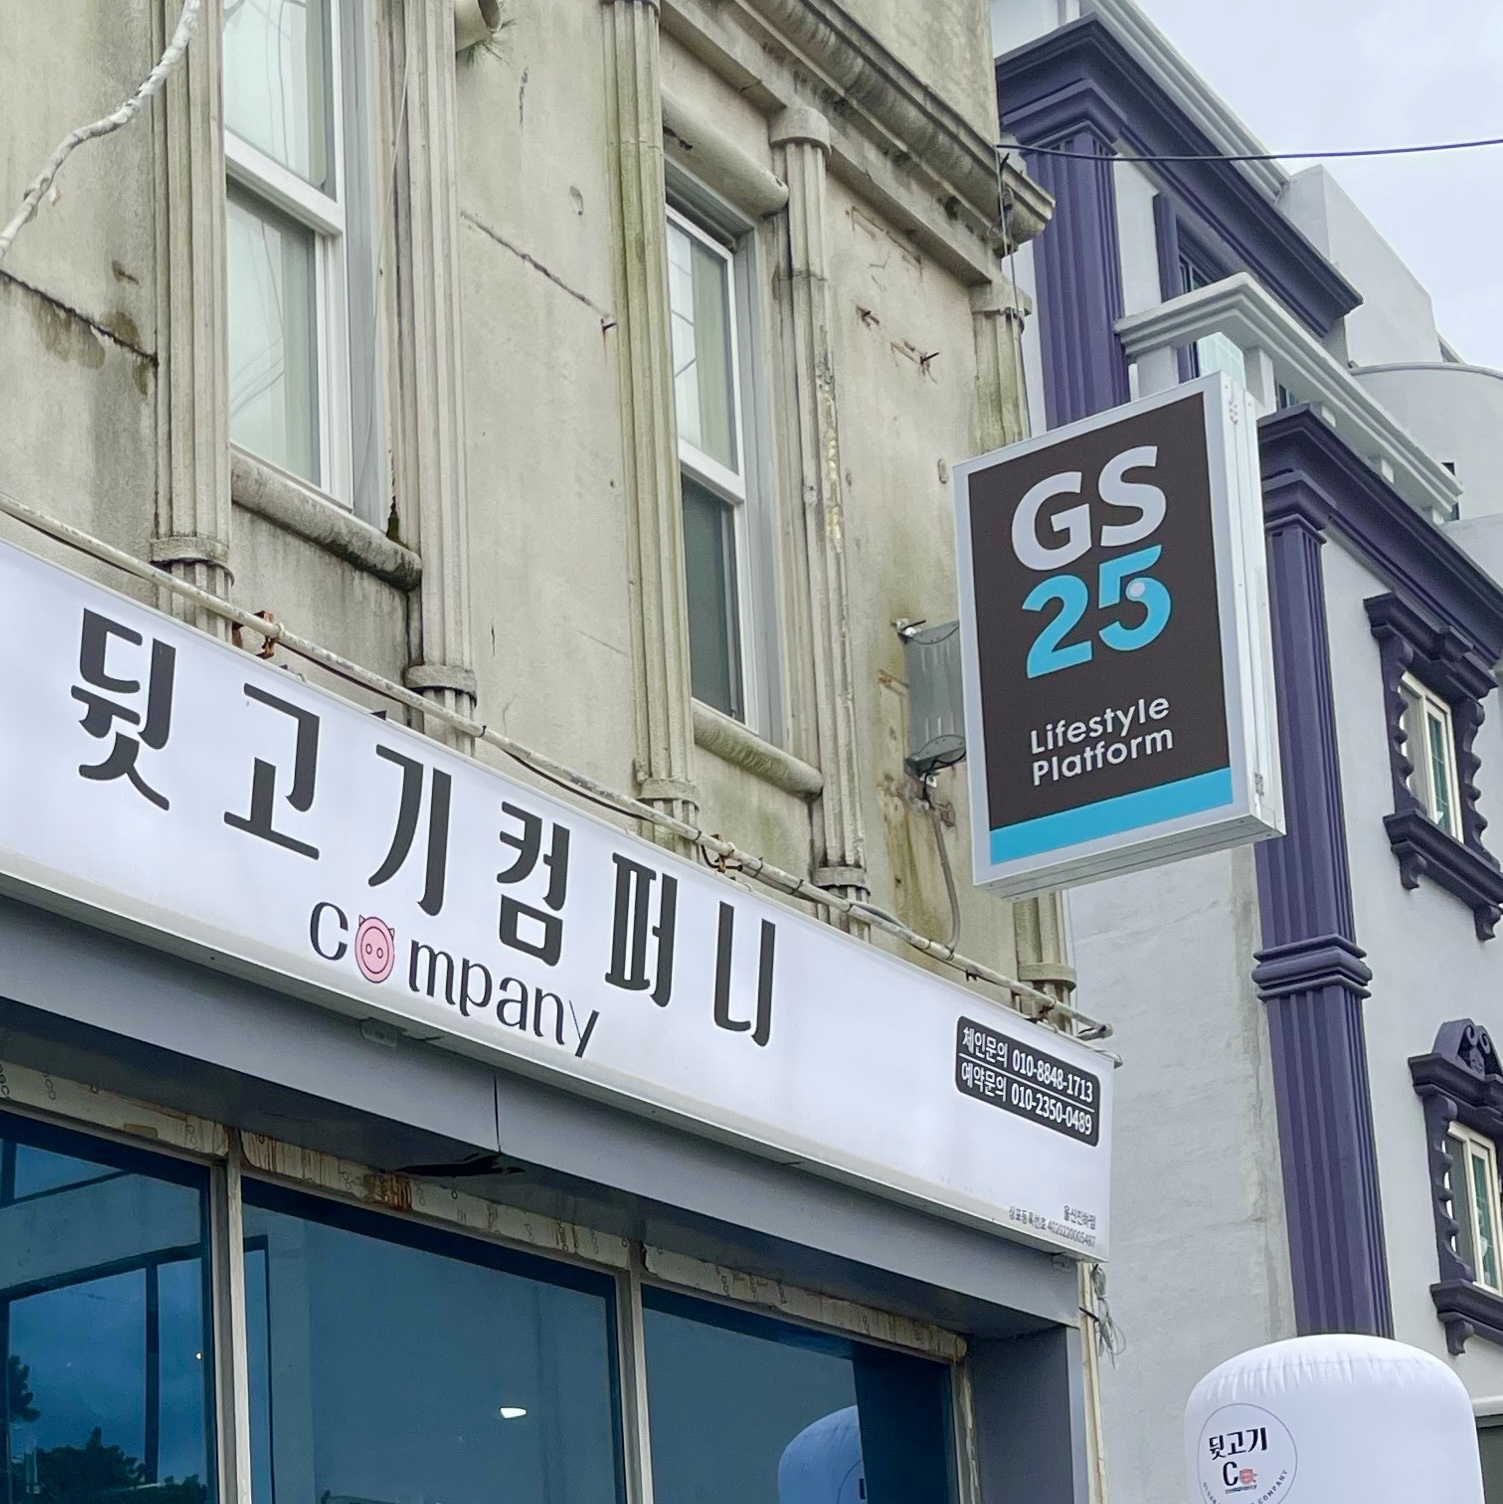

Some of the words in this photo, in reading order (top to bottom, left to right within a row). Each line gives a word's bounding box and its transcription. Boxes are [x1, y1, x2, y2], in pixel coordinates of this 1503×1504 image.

[1010, 444, 1168, 571] GS
[1021, 544, 1173, 680] 25
[1029, 696, 1172, 756] Lifestyle
[1032, 726, 1174, 787] Platform
[962, 1026, 1009, 1068] 체인문의
[1012, 1049, 1094, 1103] 010-8848-1713
[961, 1062, 1007, 1102] 예약문의
[1011, 1083, 1093, 1135] 010-2350-0489
[1208, 1427, 1268, 1461] 뒷고기
[1257, 1469, 1289, 1504] COMPANY
